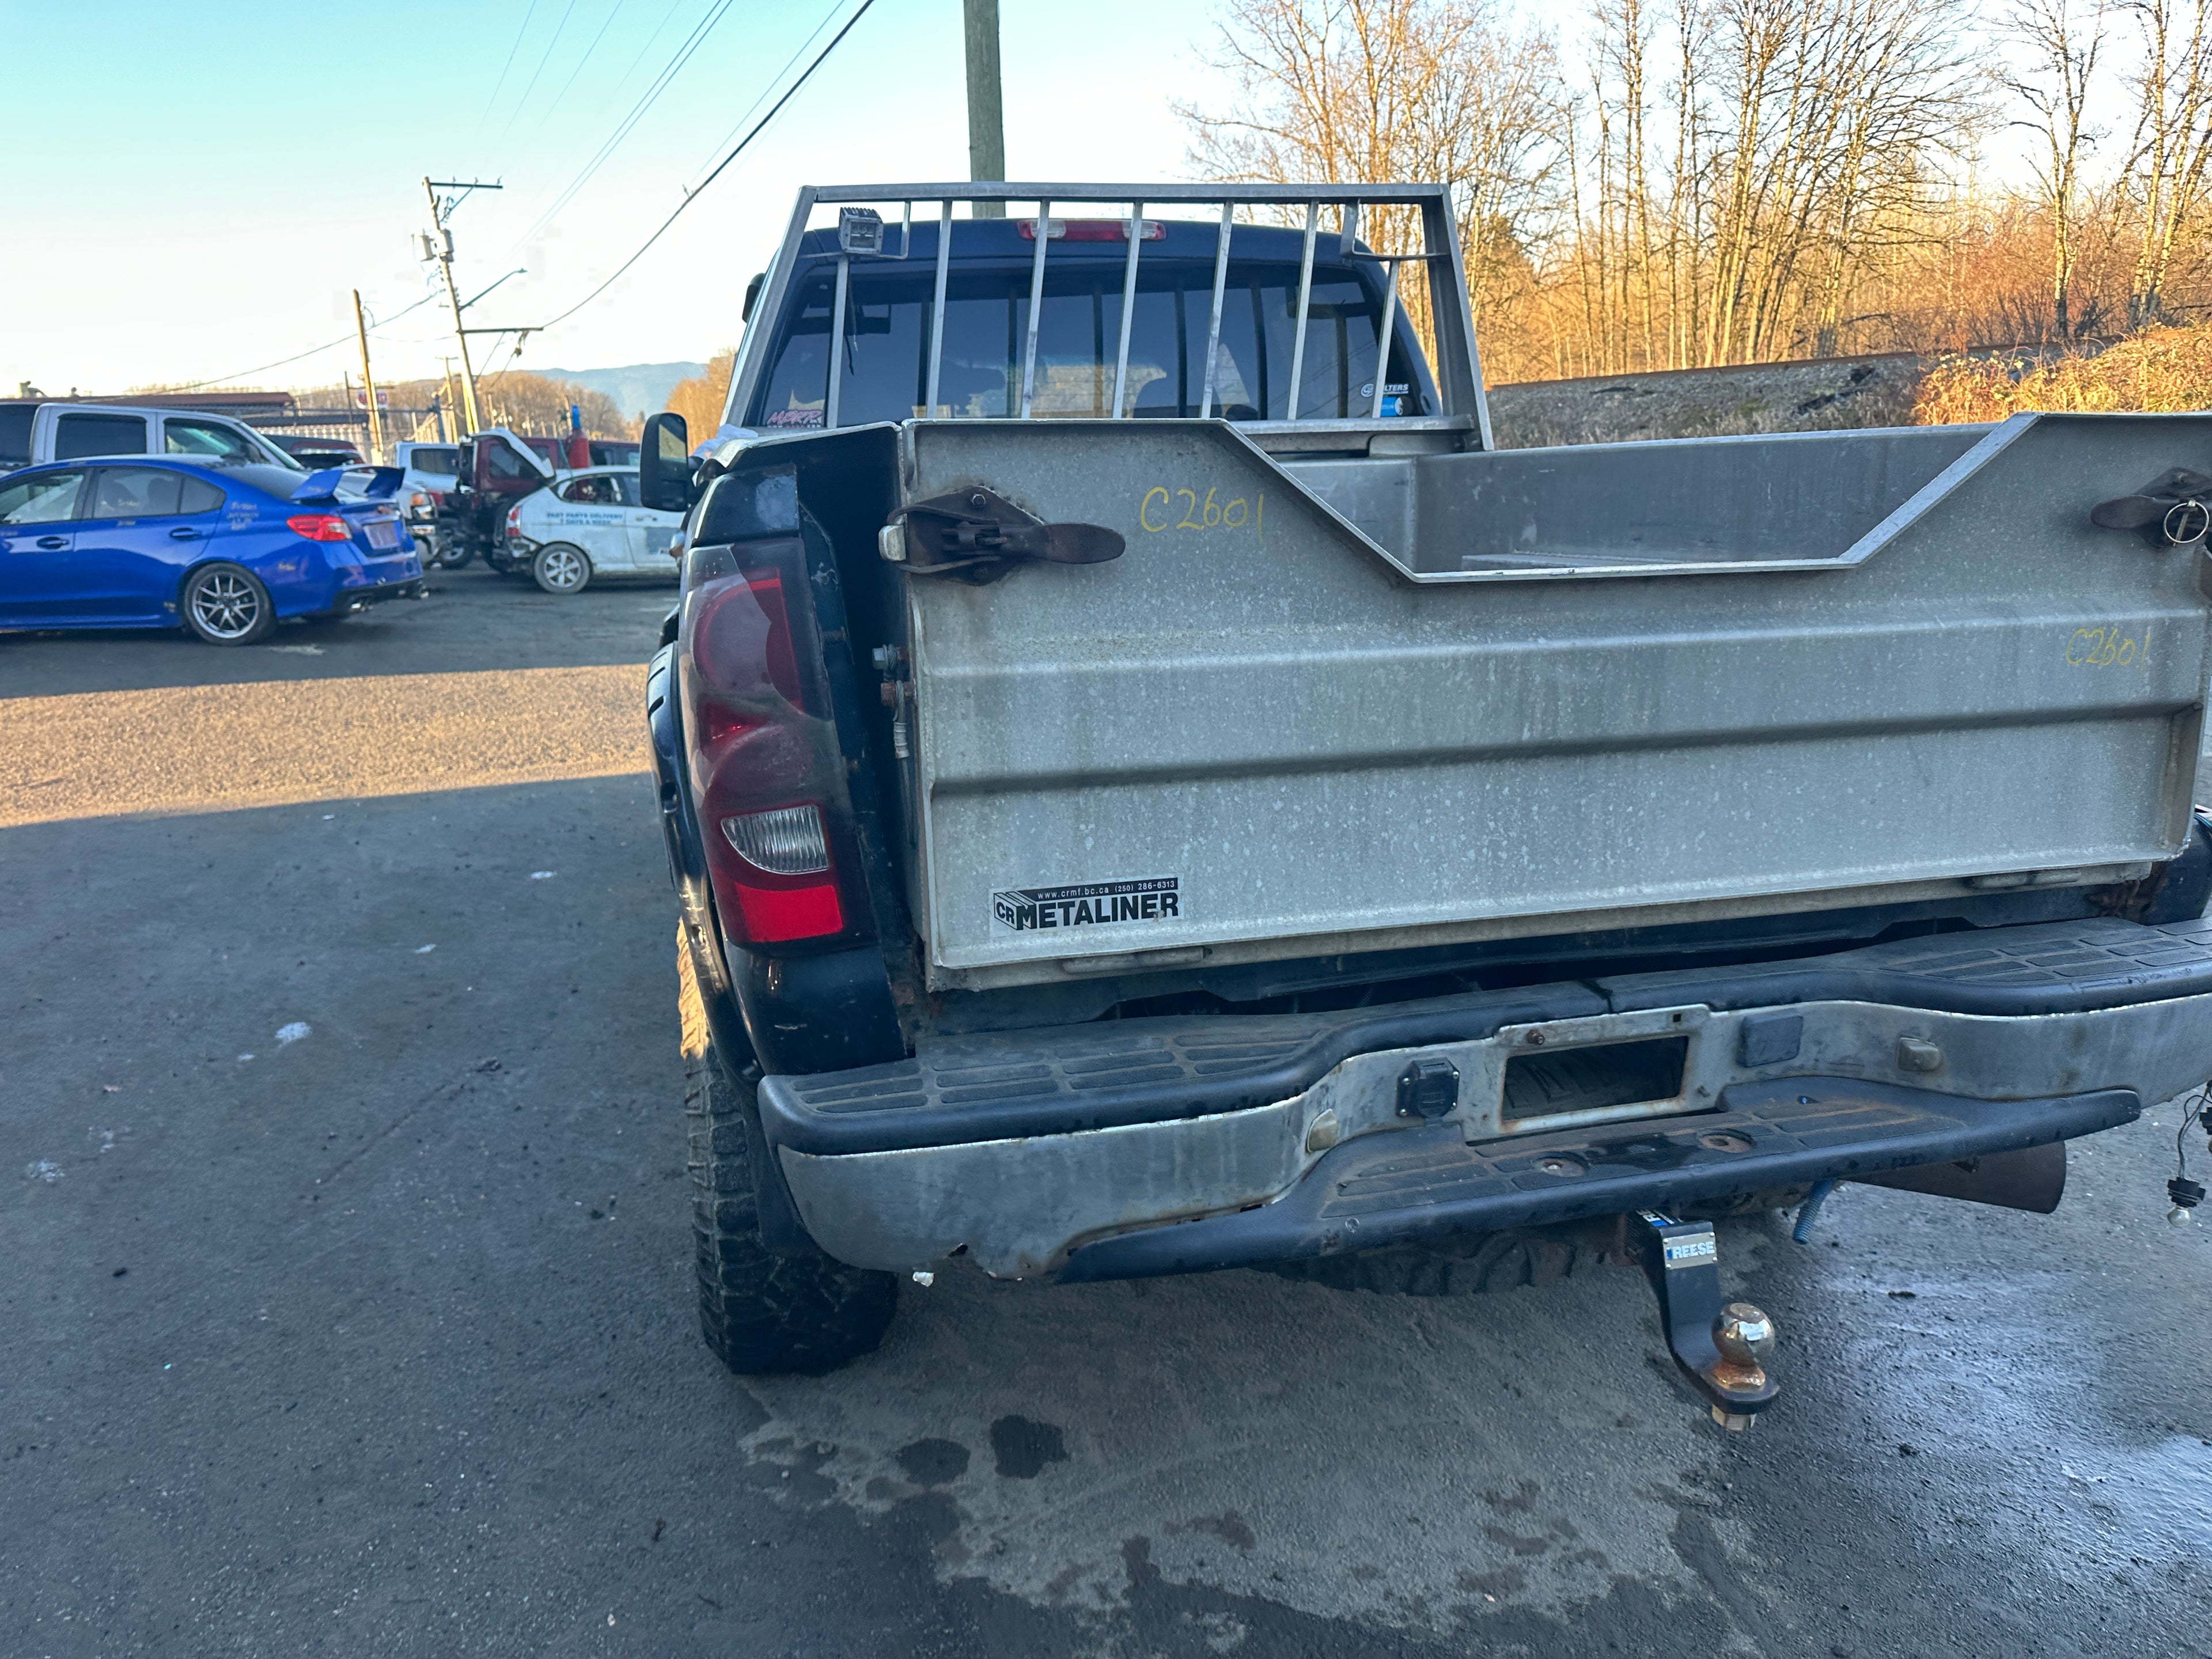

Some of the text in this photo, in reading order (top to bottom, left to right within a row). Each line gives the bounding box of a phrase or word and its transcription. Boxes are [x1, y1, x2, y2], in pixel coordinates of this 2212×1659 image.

[1141, 486, 1264, 544] C2601
[2066, 628, 2152, 678] C2601
[1037, 880, 1175, 900] www.crmf.bc.ca (250) 286-6313
[1016, 892, 1179, 930] METALINER
[1672, 1241, 1715, 1259] REESE
